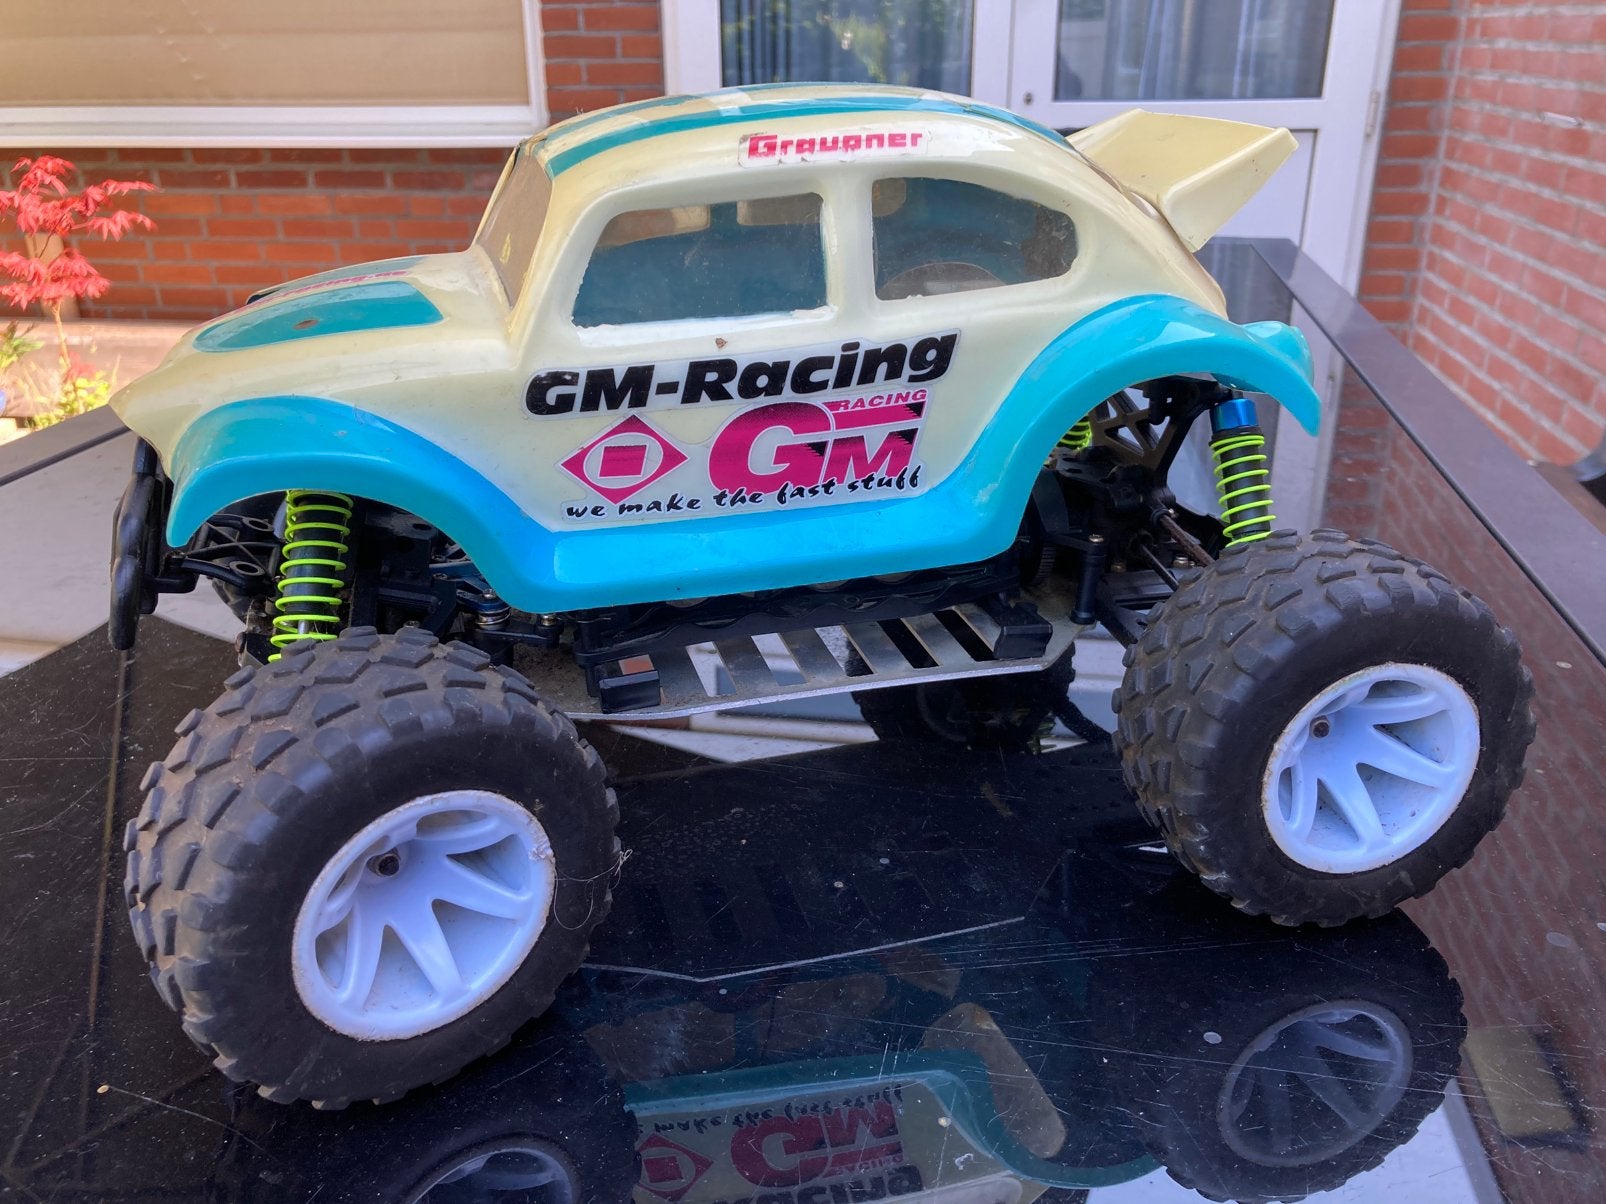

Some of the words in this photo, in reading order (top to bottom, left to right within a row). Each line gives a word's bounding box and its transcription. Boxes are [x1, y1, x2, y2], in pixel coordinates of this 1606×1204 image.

[747, 132, 923, 160] Graupner
[525, 332, 958, 416] GM-Racing
[836, 389, 928, 412] RACING
[708, 401, 919, 498] GM
[566, 504, 606, 518] we
[618, 493, 701, 515] make
[712, 487, 764, 507] the
[776, 478, 836, 505] fast
[847, 464, 922, 493] stuff
